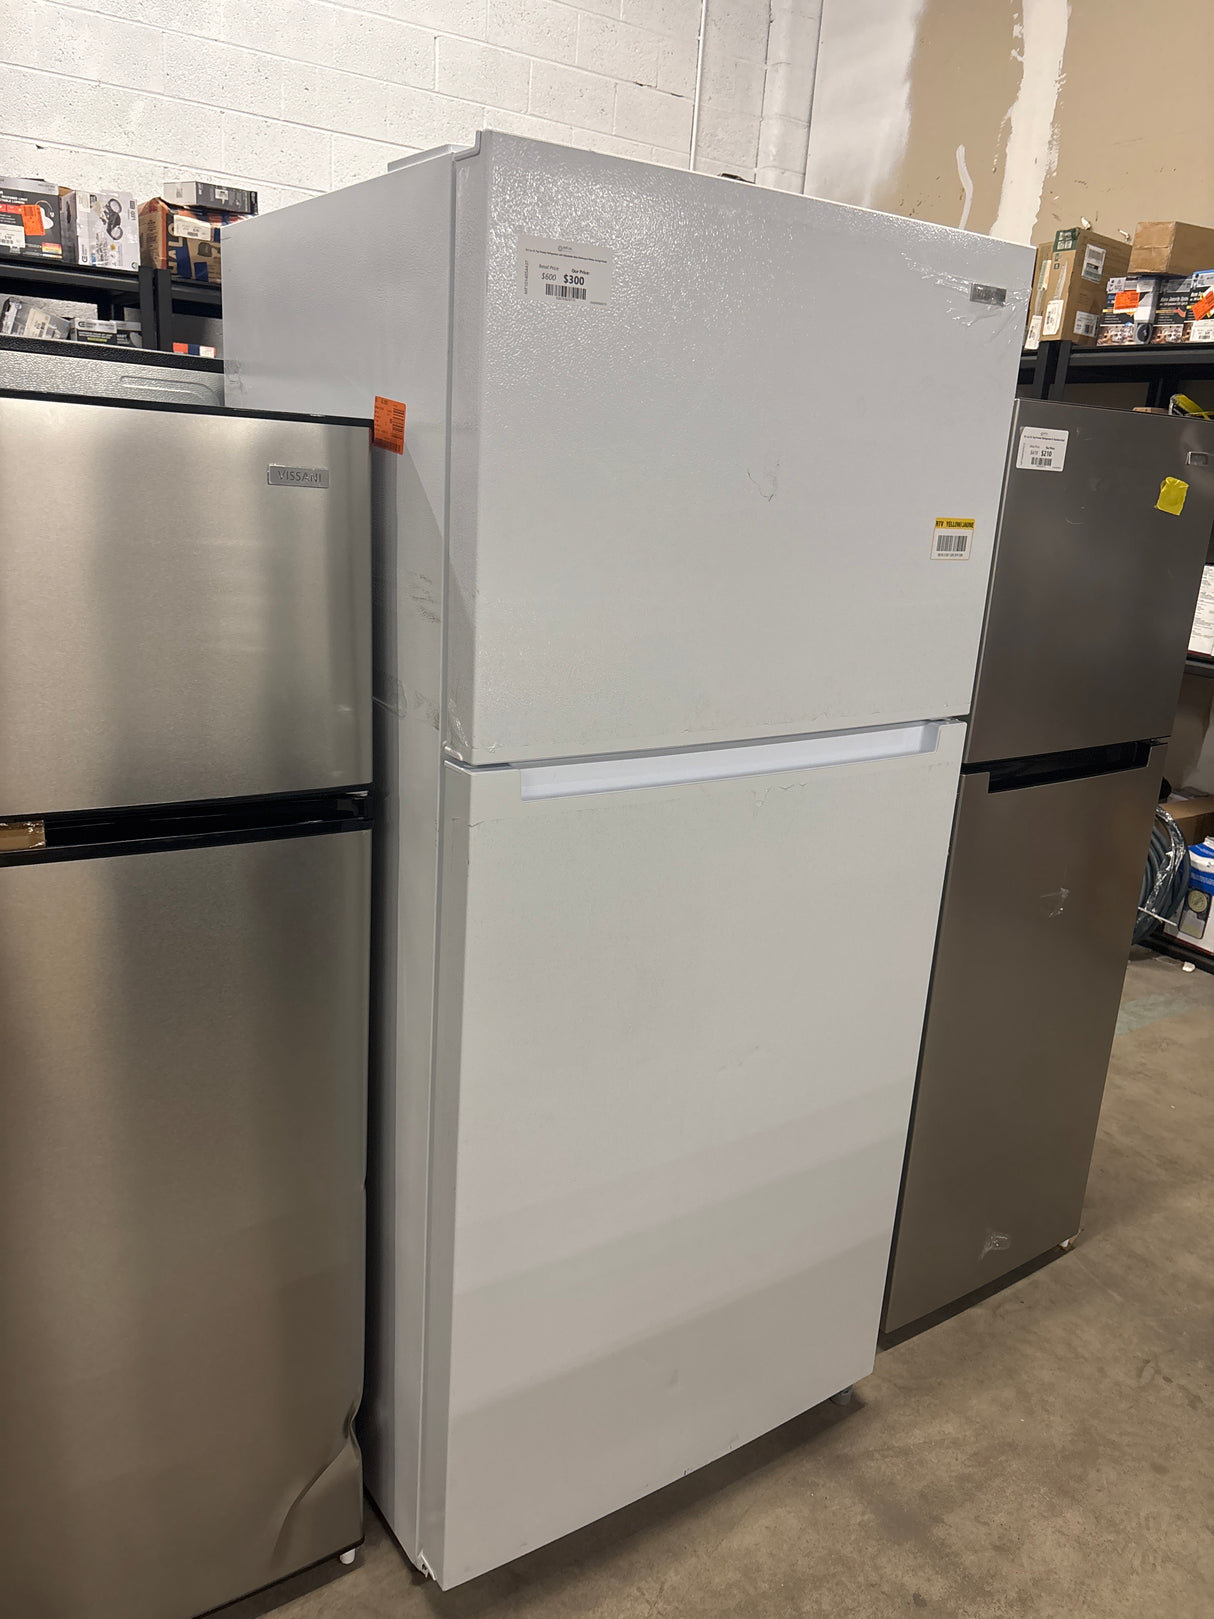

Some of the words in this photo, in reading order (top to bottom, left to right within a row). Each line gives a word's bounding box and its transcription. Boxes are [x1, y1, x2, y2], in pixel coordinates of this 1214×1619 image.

[541, 272, 557, 281] $600
[563, 274, 585, 286] $300
[277, 470, 323, 484] VISSANI
